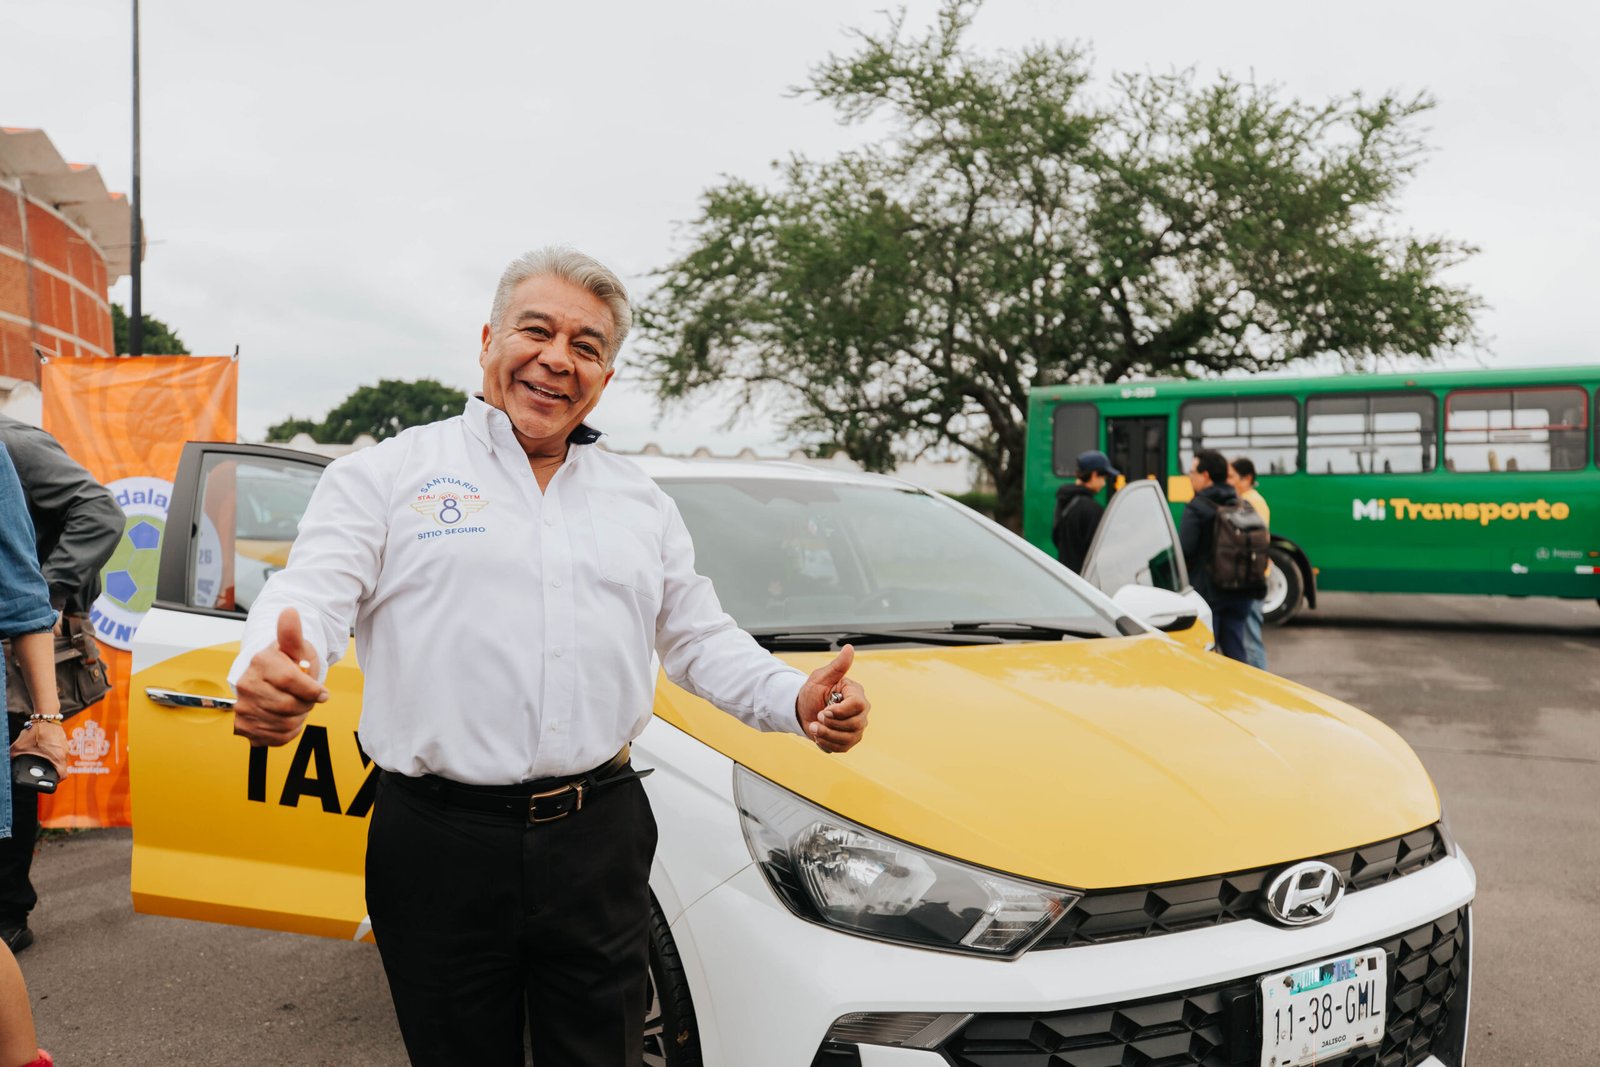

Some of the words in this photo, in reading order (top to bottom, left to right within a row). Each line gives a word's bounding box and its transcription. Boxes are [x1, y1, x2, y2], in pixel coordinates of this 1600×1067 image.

[420, 477, 479, 493] SANTUARIO
[115, 487, 169, 513] dala
[439, 498, 461, 524] 8
[1353, 498, 1386, 521] Mi
[1389, 497, 1570, 526] Transporte
[417, 530, 442, 540] SITIO
[445, 526, 486, 535] SEGURO
[89, 605, 138, 643] MUN
[1274, 979, 1381, 1046] 11-38-GML
[1321, 1034, 1347, 1048] JALISCO
